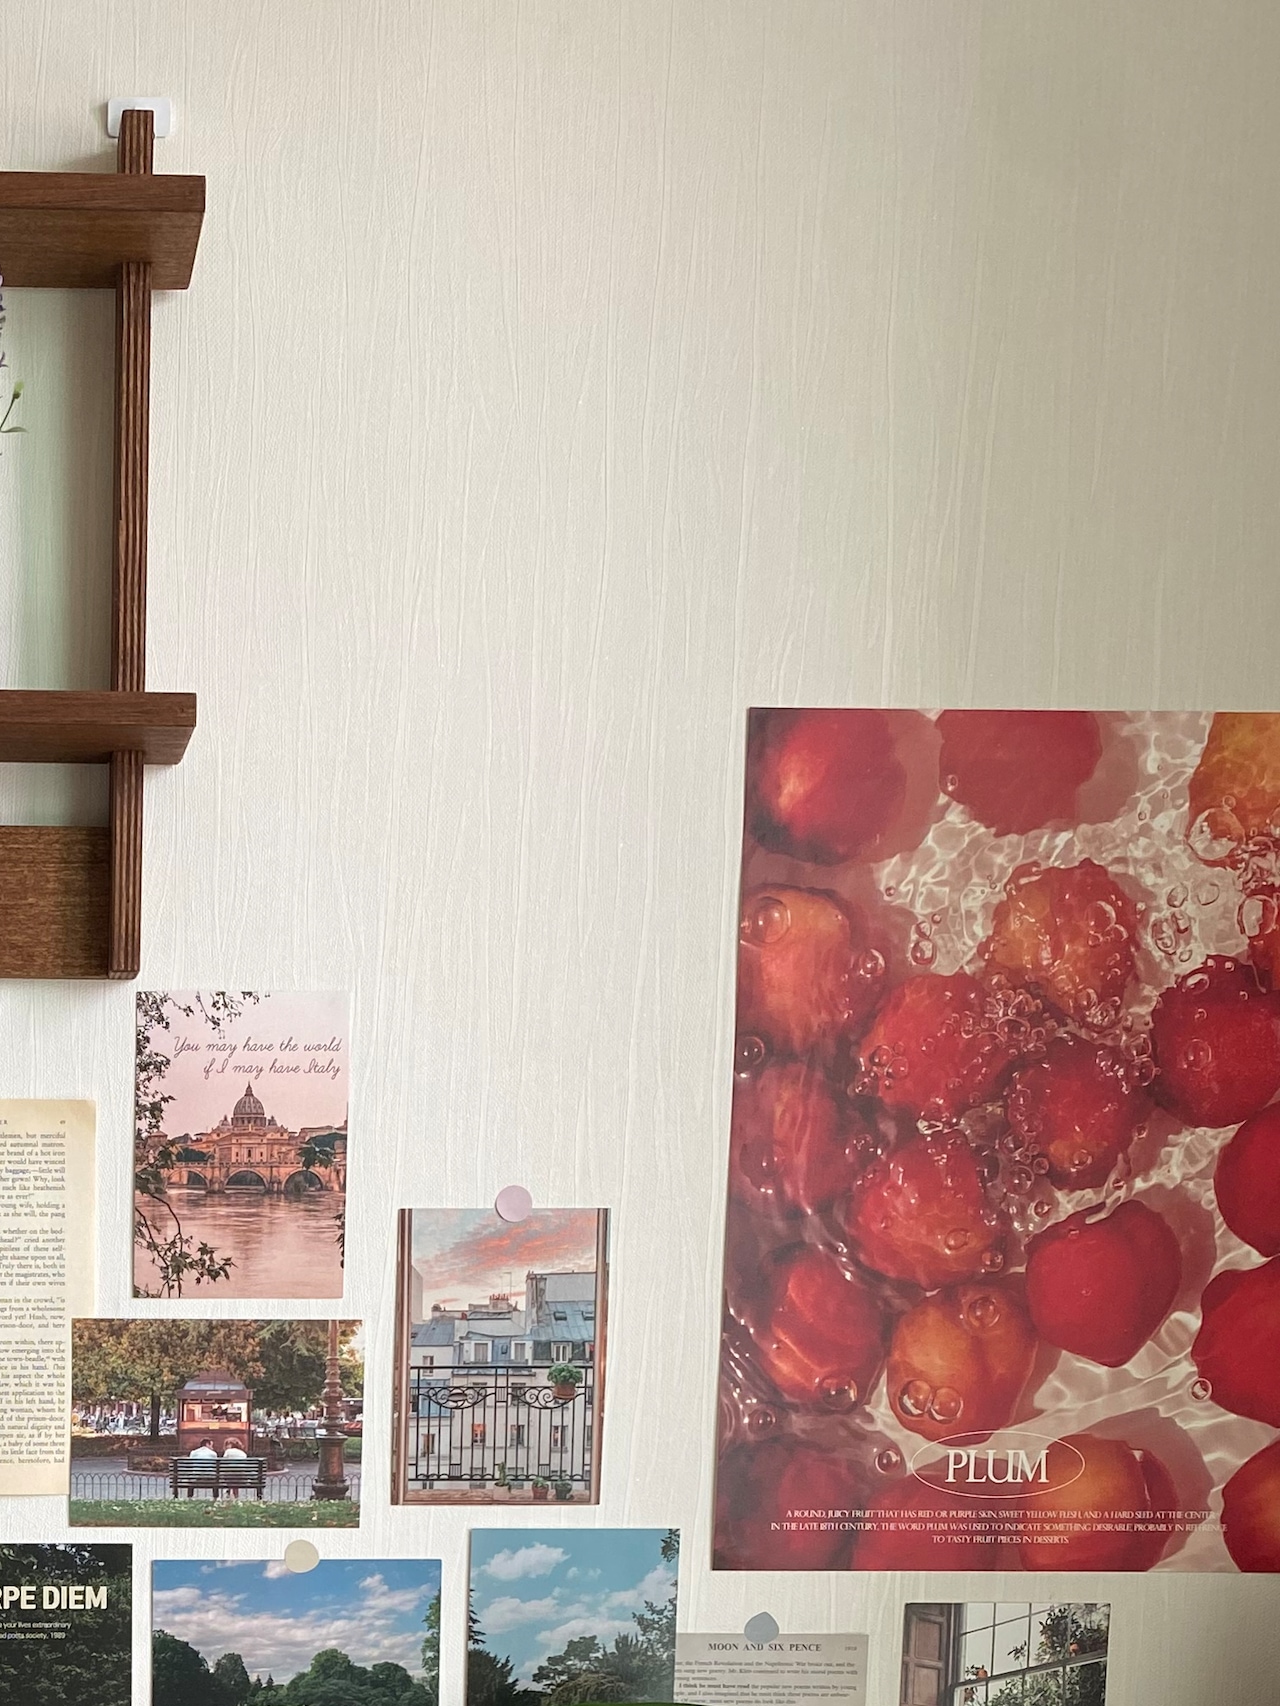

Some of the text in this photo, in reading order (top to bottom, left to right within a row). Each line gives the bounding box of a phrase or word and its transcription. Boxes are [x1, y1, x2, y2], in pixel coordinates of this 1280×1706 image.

[174, 1036, 343, 1058] You may have the world
[203, 1058, 214, 1080] if
[231, 1064, 265, 1080] may
[269, 1058, 301, 1074] have
[303, 1058, 341, 1080] Italy
[945, 1450, 1050, 1483] PLUM
[932, 1534, 945, 1544] TO
[946, 1534, 971, 1544] TASTY
[972, 1534, 996, 1544] FRUIT
[1022, 1534, 1032, 1544] IN
[43, 1585, 108, 1610] DIEM
[708, 1643, 822, 1651] MOON AND SIX PENCE
